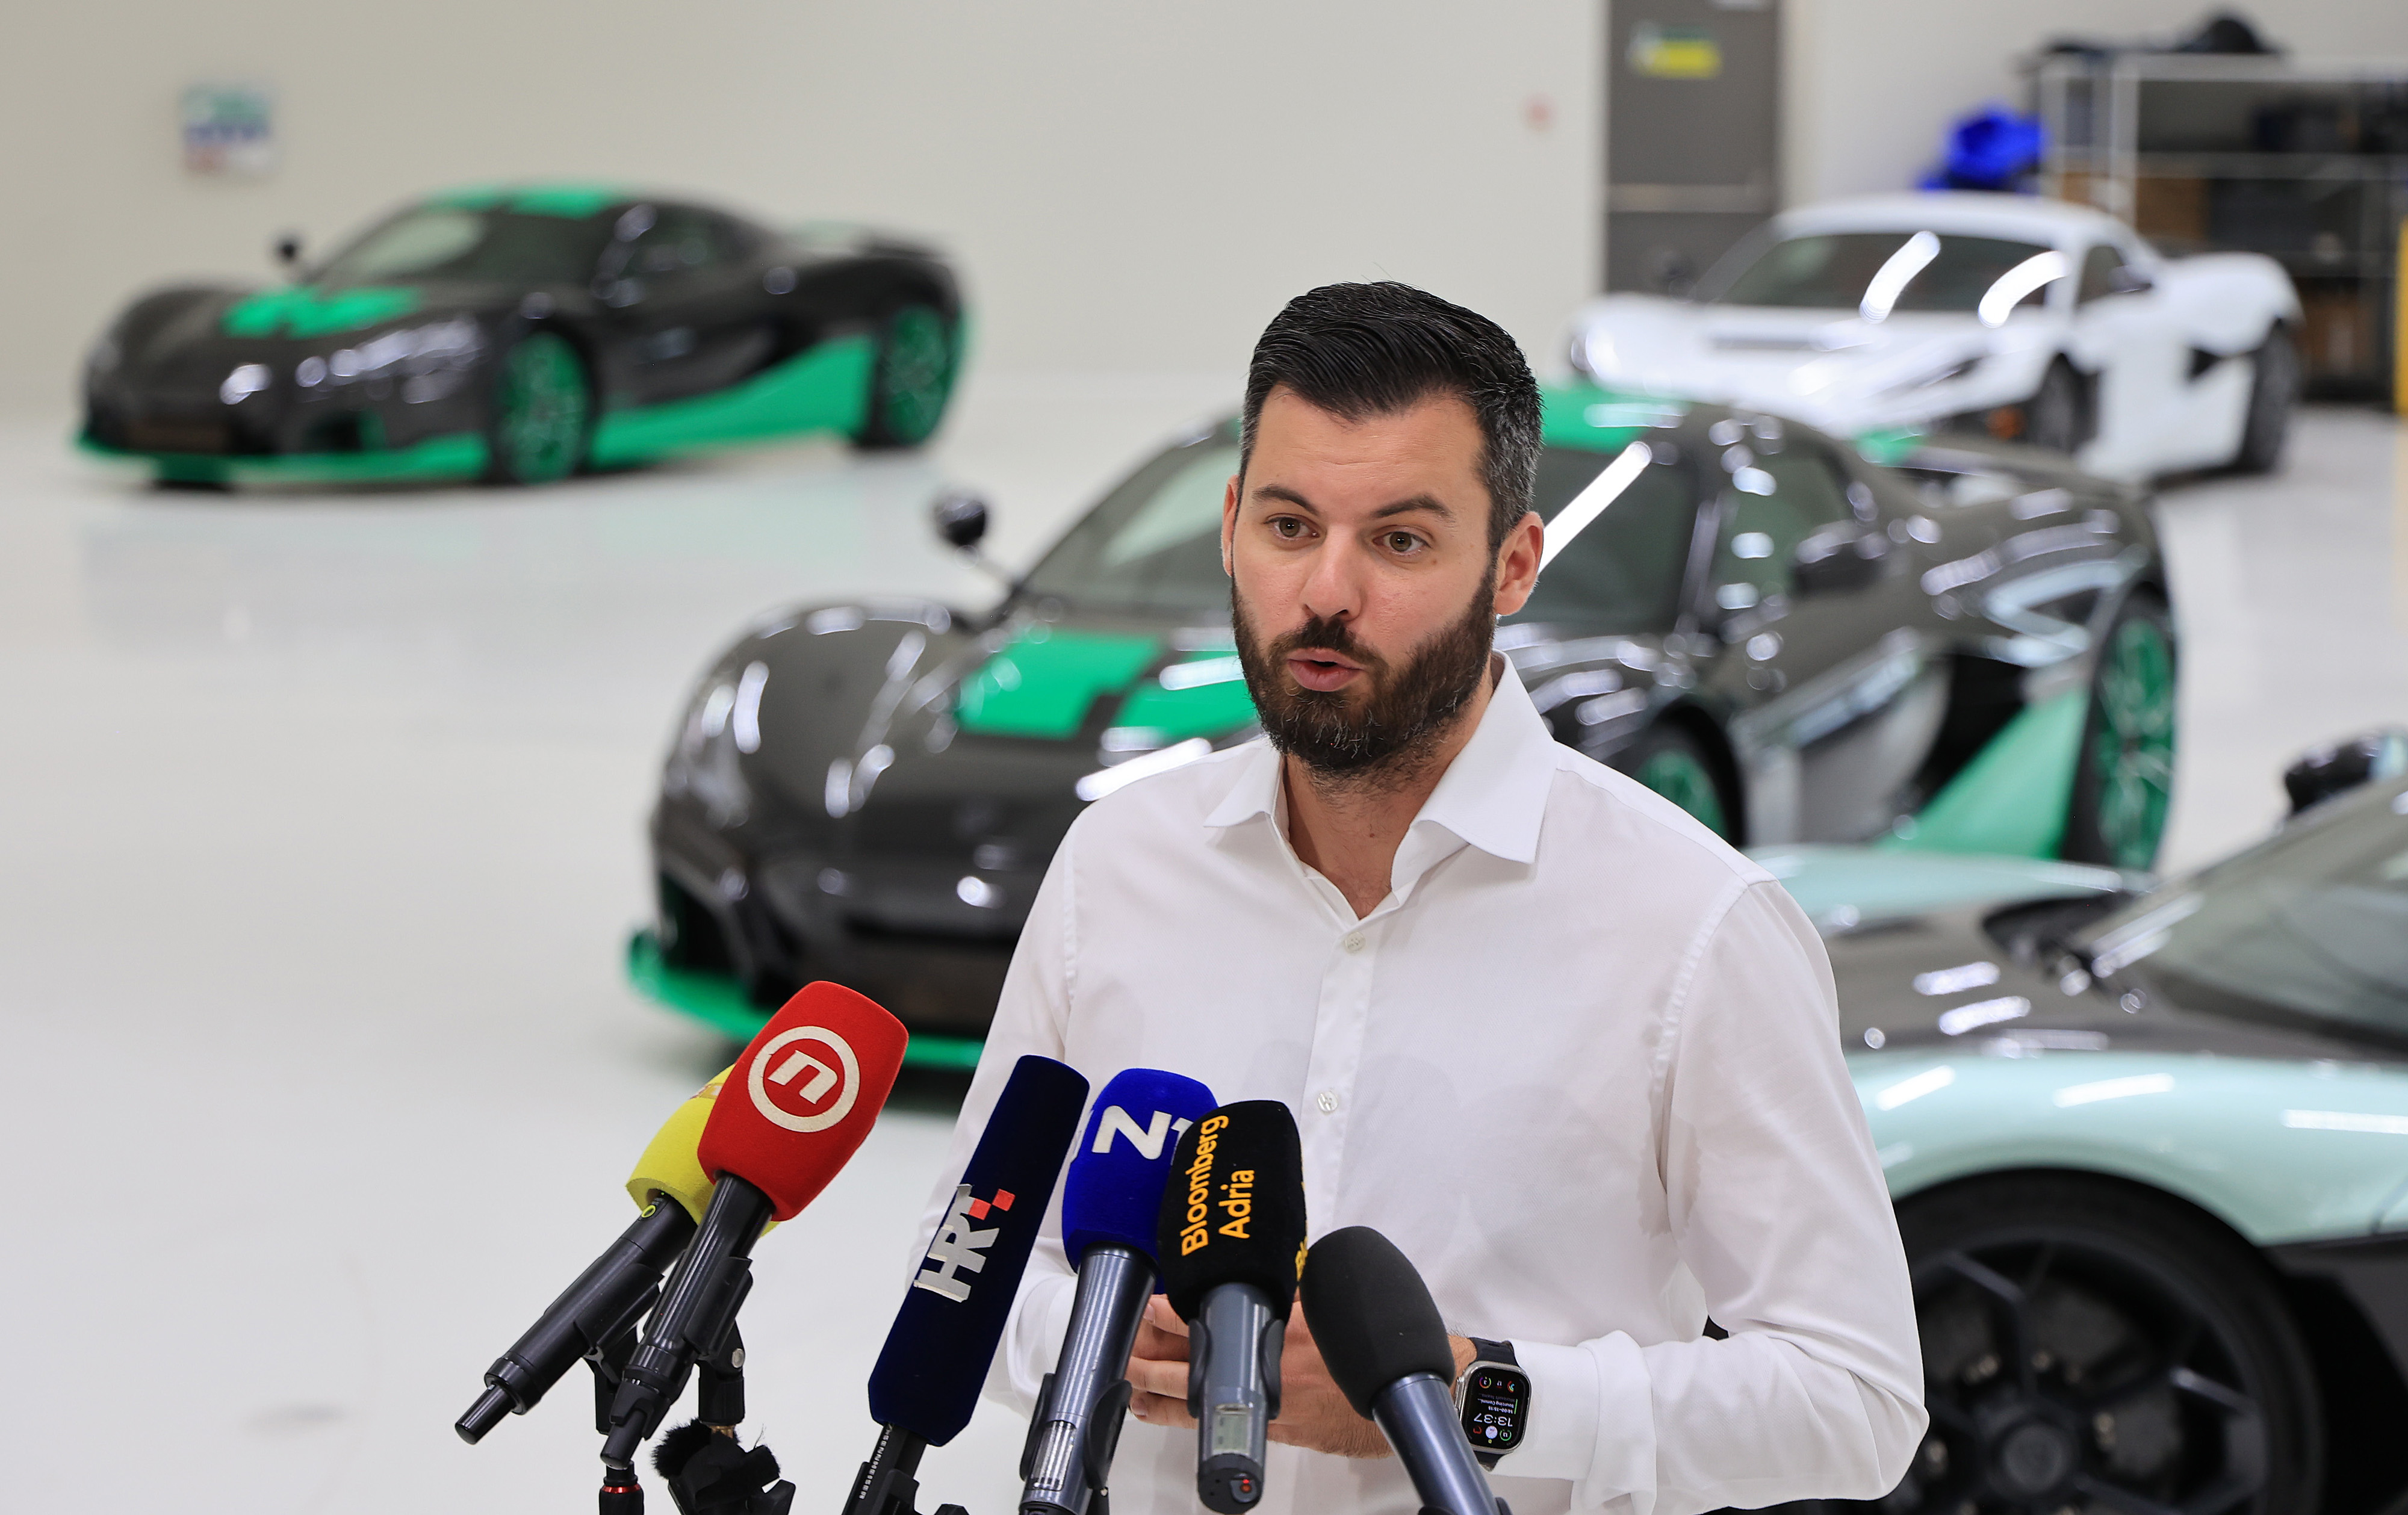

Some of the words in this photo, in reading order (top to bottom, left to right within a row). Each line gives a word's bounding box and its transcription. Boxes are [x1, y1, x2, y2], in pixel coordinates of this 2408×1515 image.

[1180, 1115, 1229, 1256] Bloomberg
[1218, 1170, 1255, 1239] Adria
[1474, 1413, 1513, 1427] 13:37
